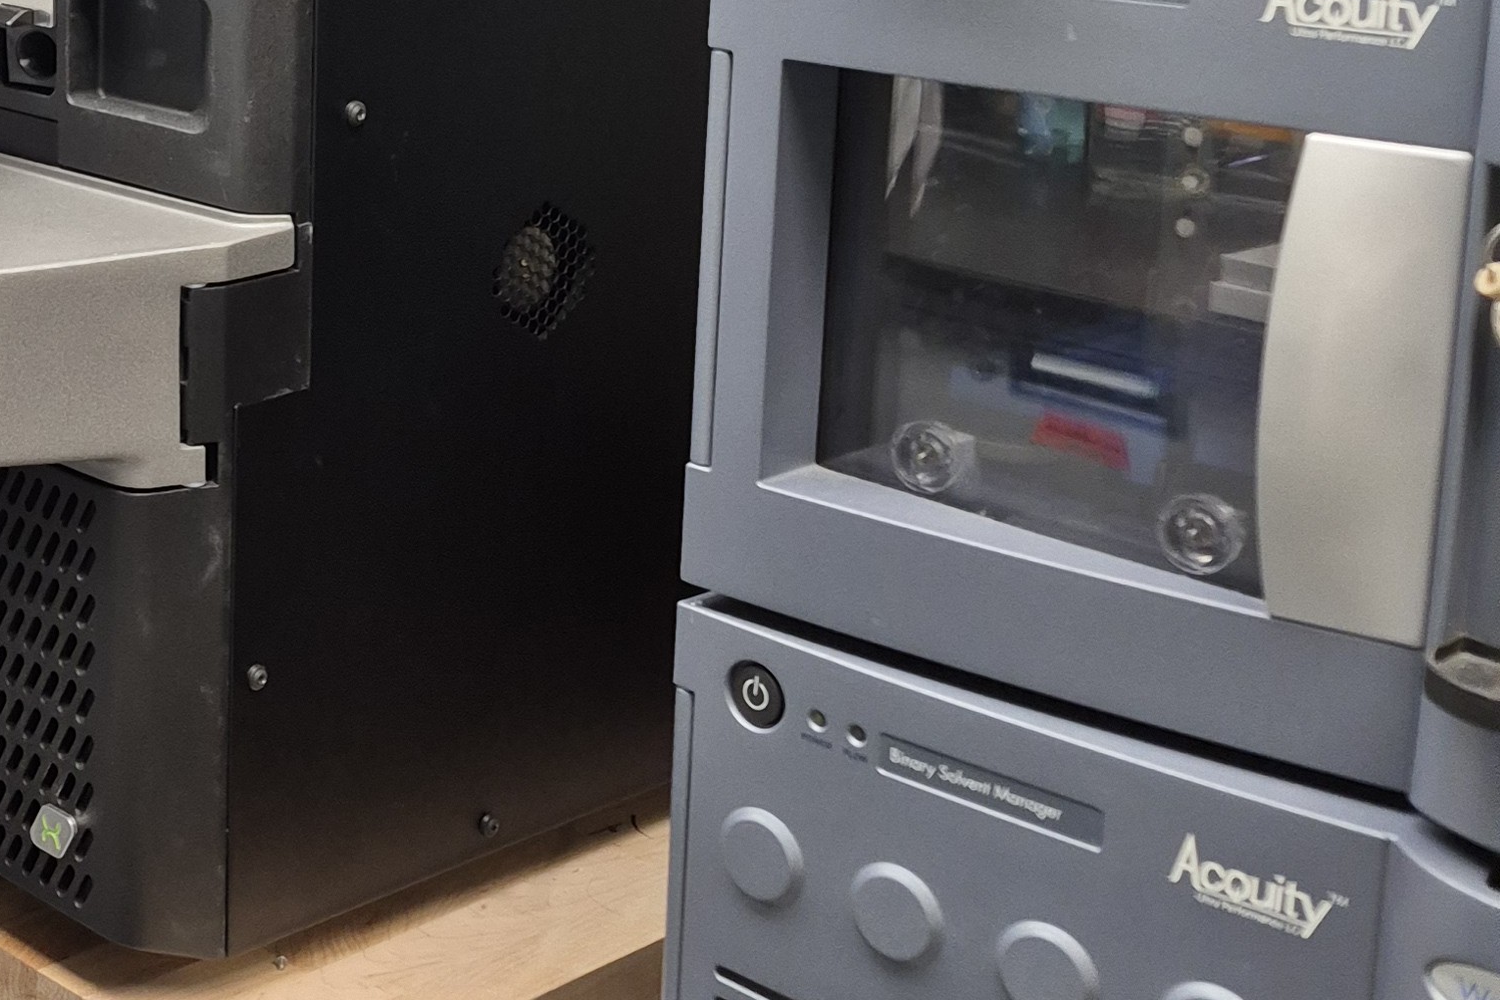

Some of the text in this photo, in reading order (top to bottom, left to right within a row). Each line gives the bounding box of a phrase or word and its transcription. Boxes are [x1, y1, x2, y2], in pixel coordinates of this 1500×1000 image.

[889, 747, 1063, 821] Binary Solvent Manager
